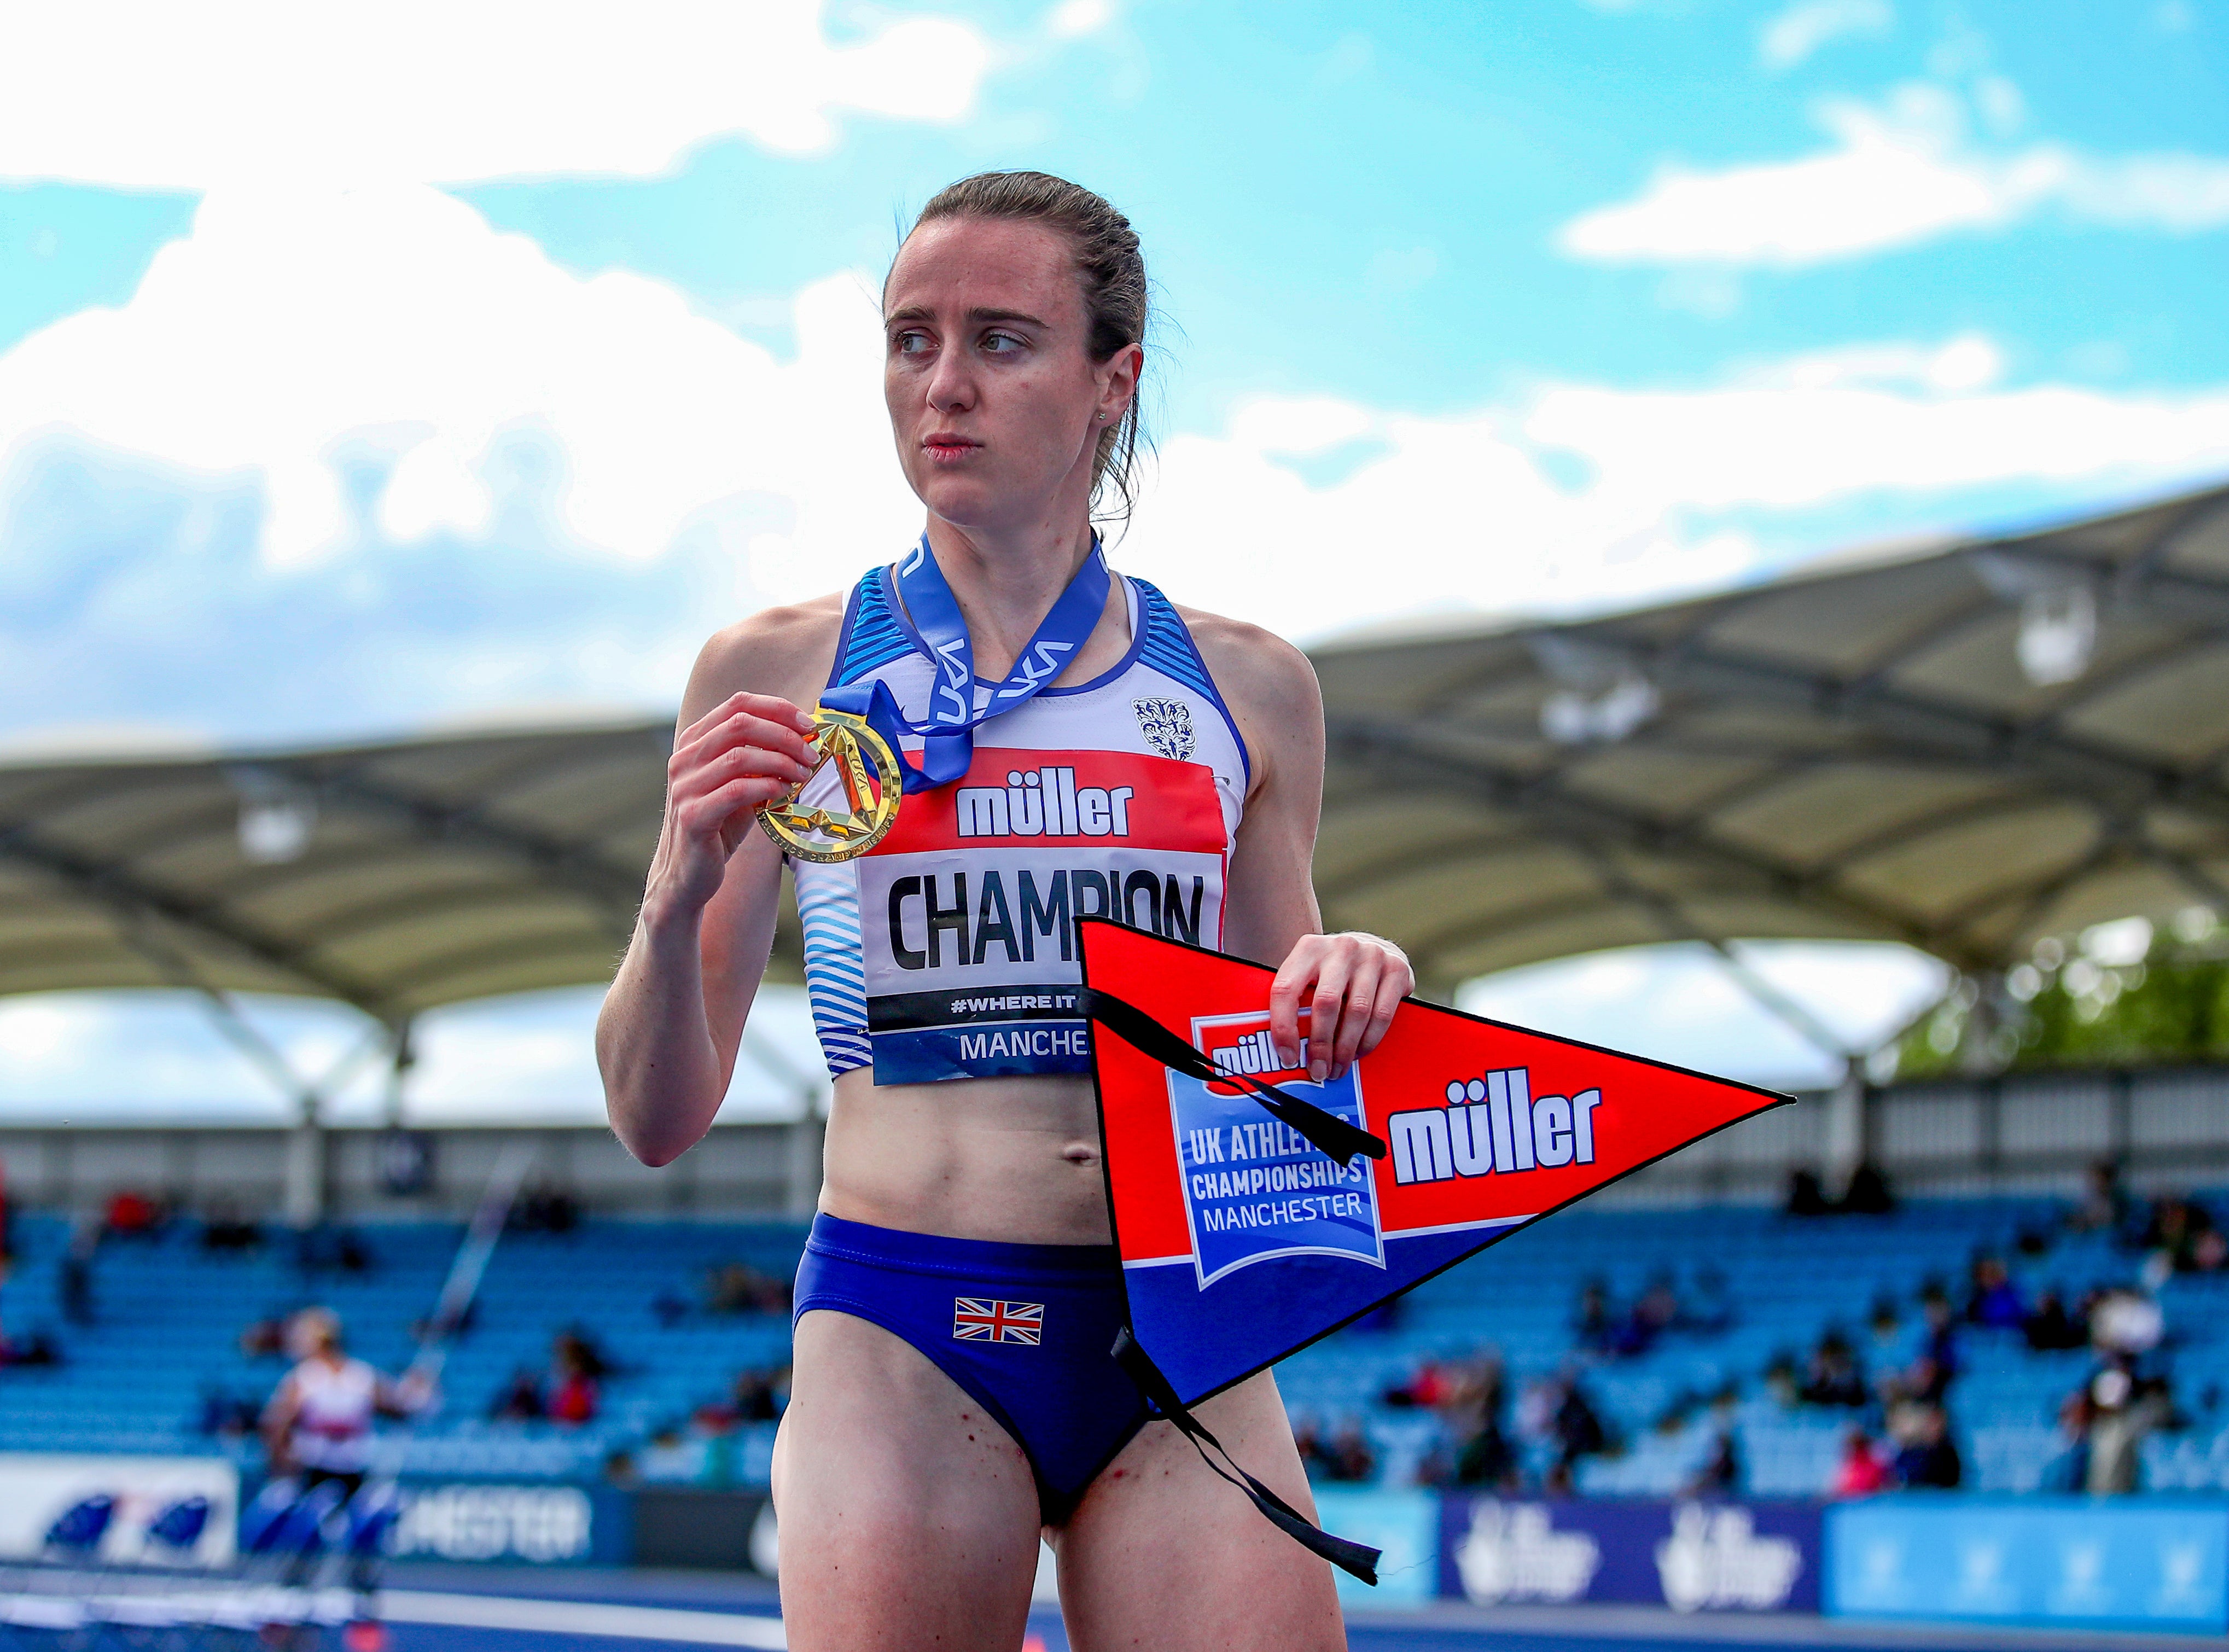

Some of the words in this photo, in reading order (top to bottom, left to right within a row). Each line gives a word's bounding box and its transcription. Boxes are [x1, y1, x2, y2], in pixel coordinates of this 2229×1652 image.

[957, 766, 1133, 837] müller
[888, 869, 1203, 970] CHAMPION
[951, 995, 1052, 1014] #WHERE
[1055, 995, 1076, 1008] IT
[960, 1030, 1091, 1060] MANCHE
[1212, 1031, 1309, 1077] müllr
[1190, 1127, 1225, 1165] UK
[1231, 1113, 1350, 1161] ATHLE
[1389, 1067, 1601, 1185] müller
[1192, 1156, 1362, 1200] CHAMPIONSHIPS
[1203, 1192, 1363, 1232] MANCHESTER
